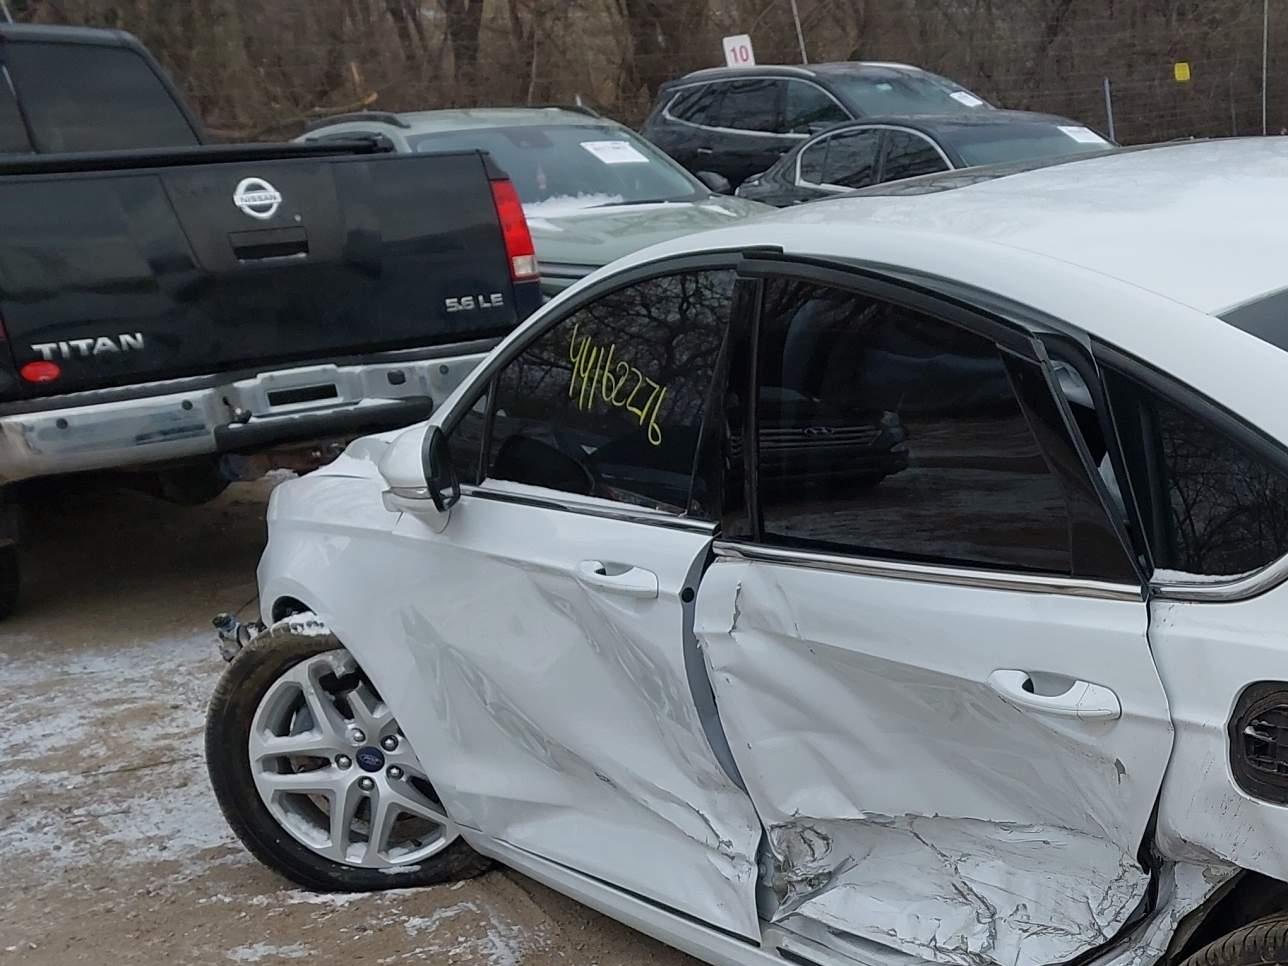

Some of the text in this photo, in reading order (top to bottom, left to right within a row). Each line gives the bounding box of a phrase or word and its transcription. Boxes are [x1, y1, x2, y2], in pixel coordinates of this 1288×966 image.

[730, 45, 749, 63] 10
[478, 293, 504, 308] LE
[31, 332, 145, 360] TITAN
[569, 323, 667, 445] 44162276
